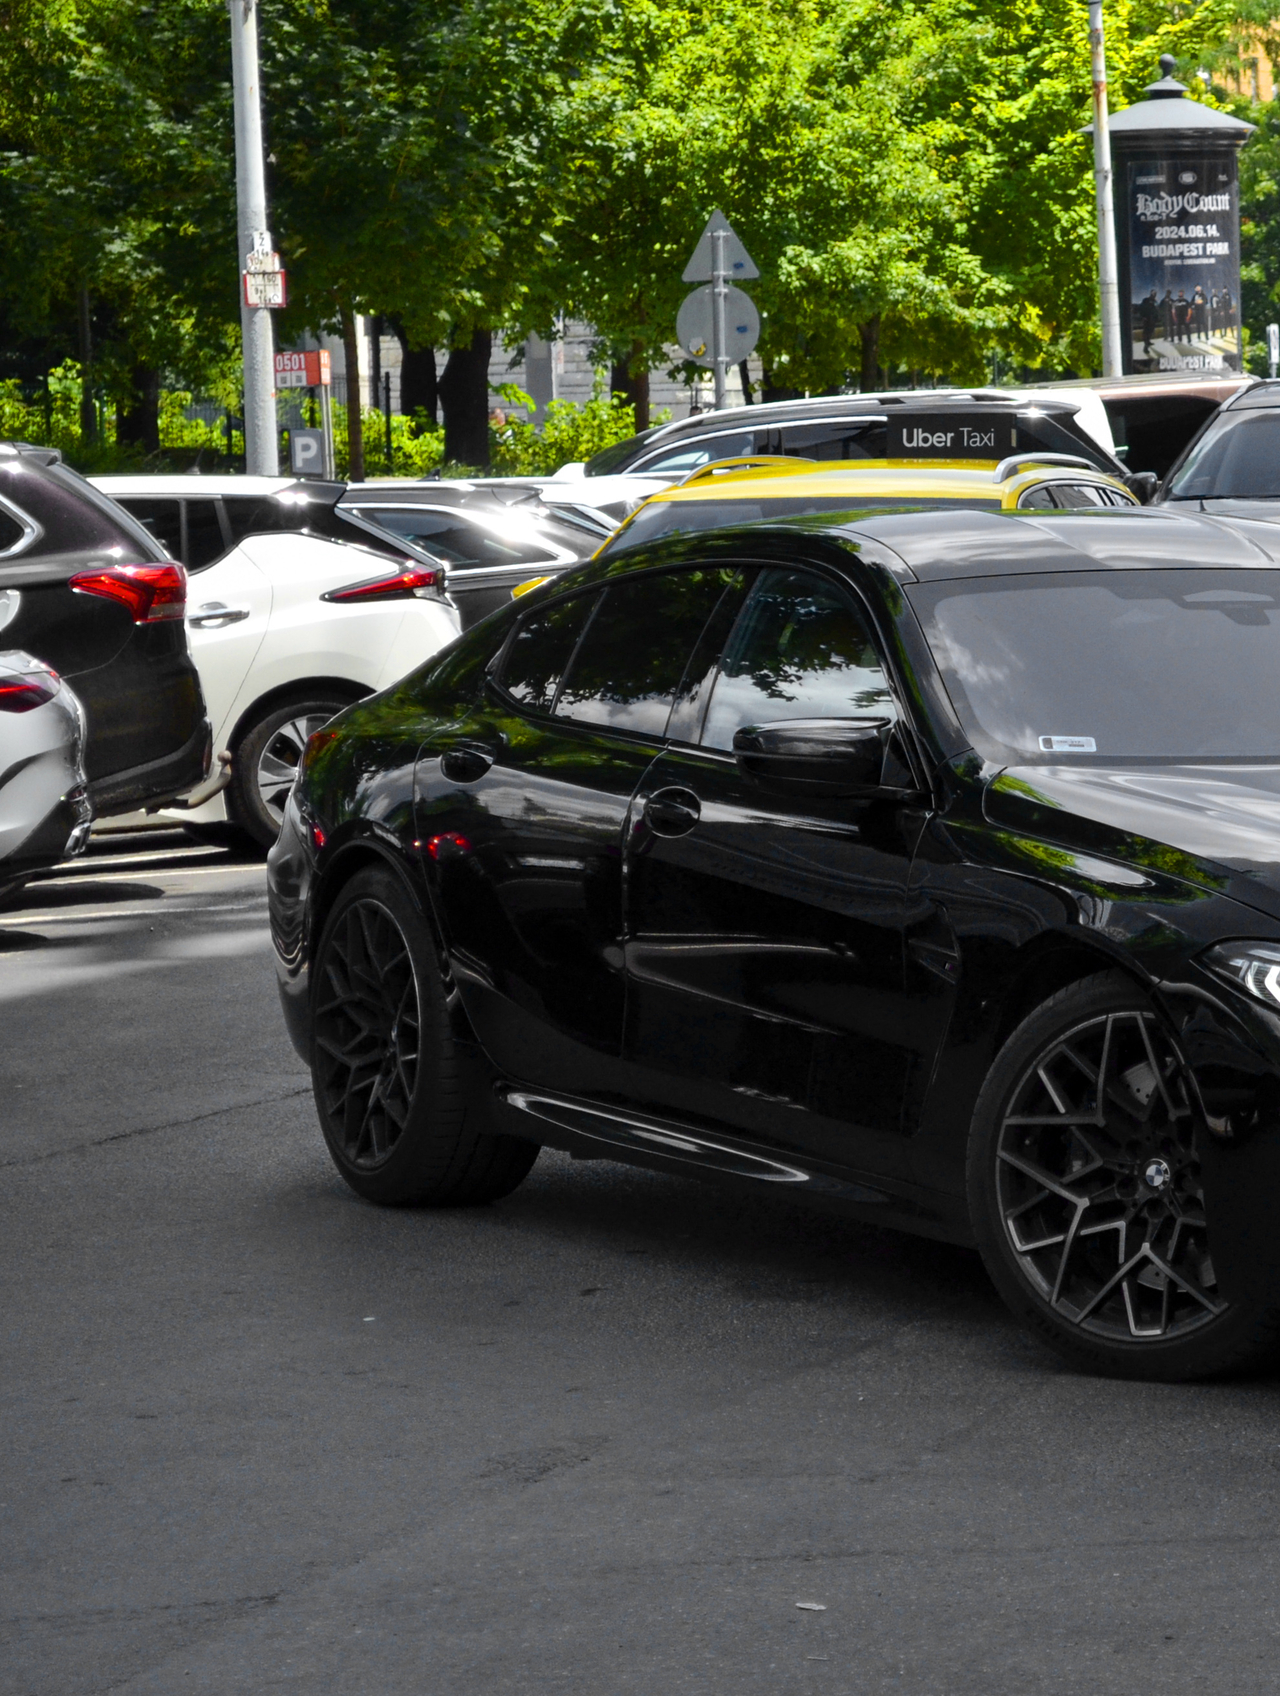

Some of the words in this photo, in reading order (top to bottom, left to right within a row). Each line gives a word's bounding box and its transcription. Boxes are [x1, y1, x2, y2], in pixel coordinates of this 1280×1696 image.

[1136, 191, 1182, 218] Body
[1183, 192, 1230, 213] Count
[1155, 224, 1220, 239] 2024.06.14.
[1142, 243, 1204, 258] BUDAPEST
[1206, 242, 1230, 255] PARK
[275, 353, 305, 371] 0501
[902, 428, 954, 447] Uber
[959, 427, 994, 447] Taxi
[294, 436, 318, 468] P
